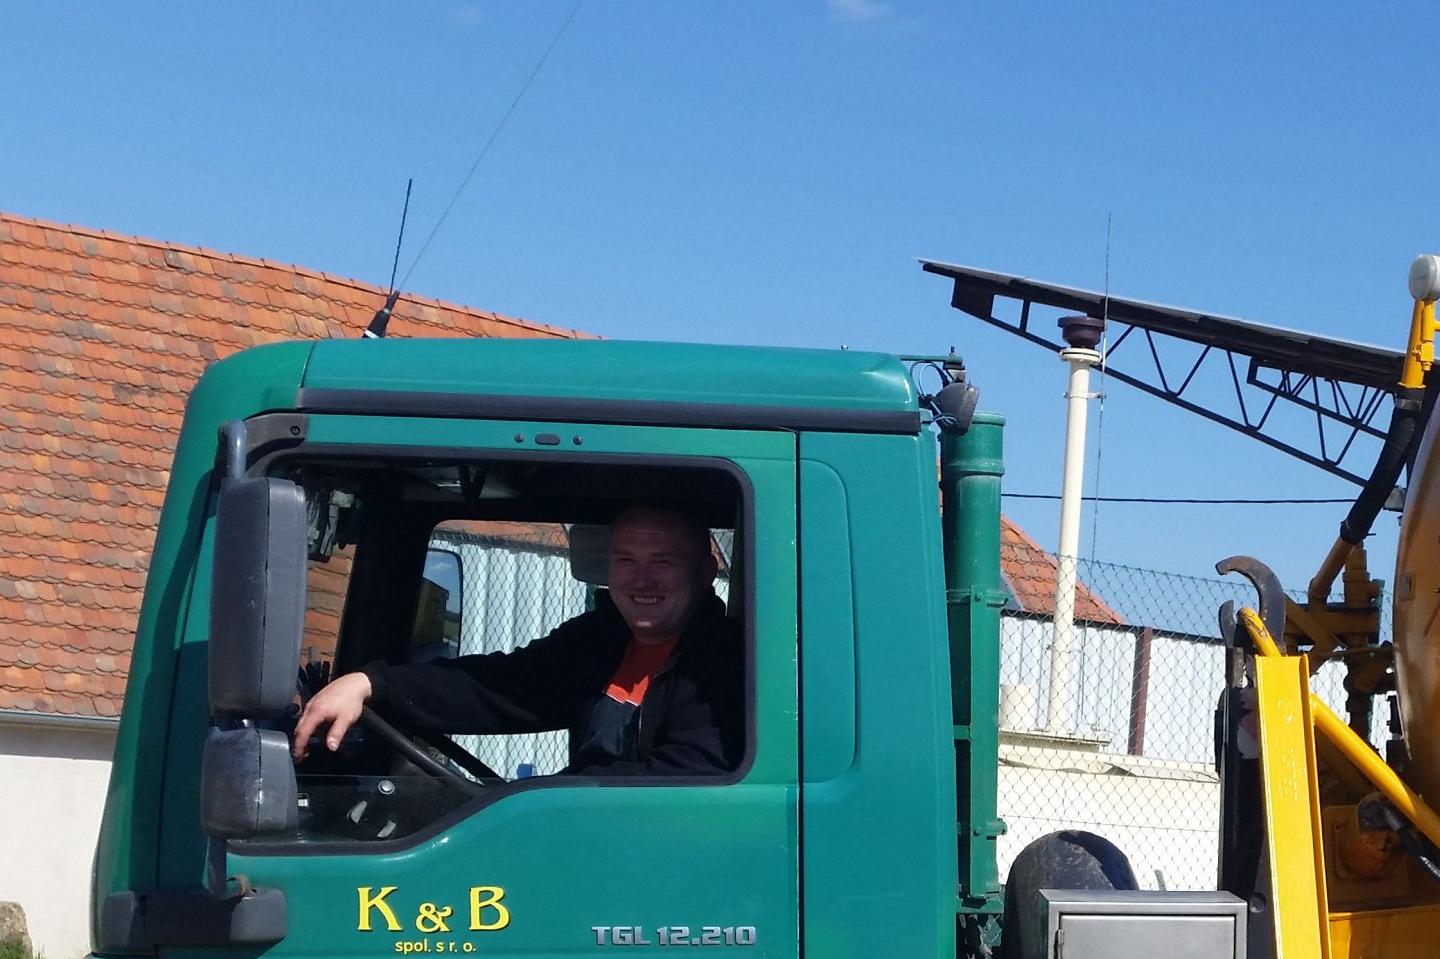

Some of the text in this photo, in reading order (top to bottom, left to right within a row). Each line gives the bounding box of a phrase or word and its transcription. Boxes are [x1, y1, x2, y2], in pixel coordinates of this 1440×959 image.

[357, 886, 510, 933] K & B
[394, 938, 431, 955] spol.
[436, 941, 444, 953] s
[591, 926, 757, 947] TGL 12.210
